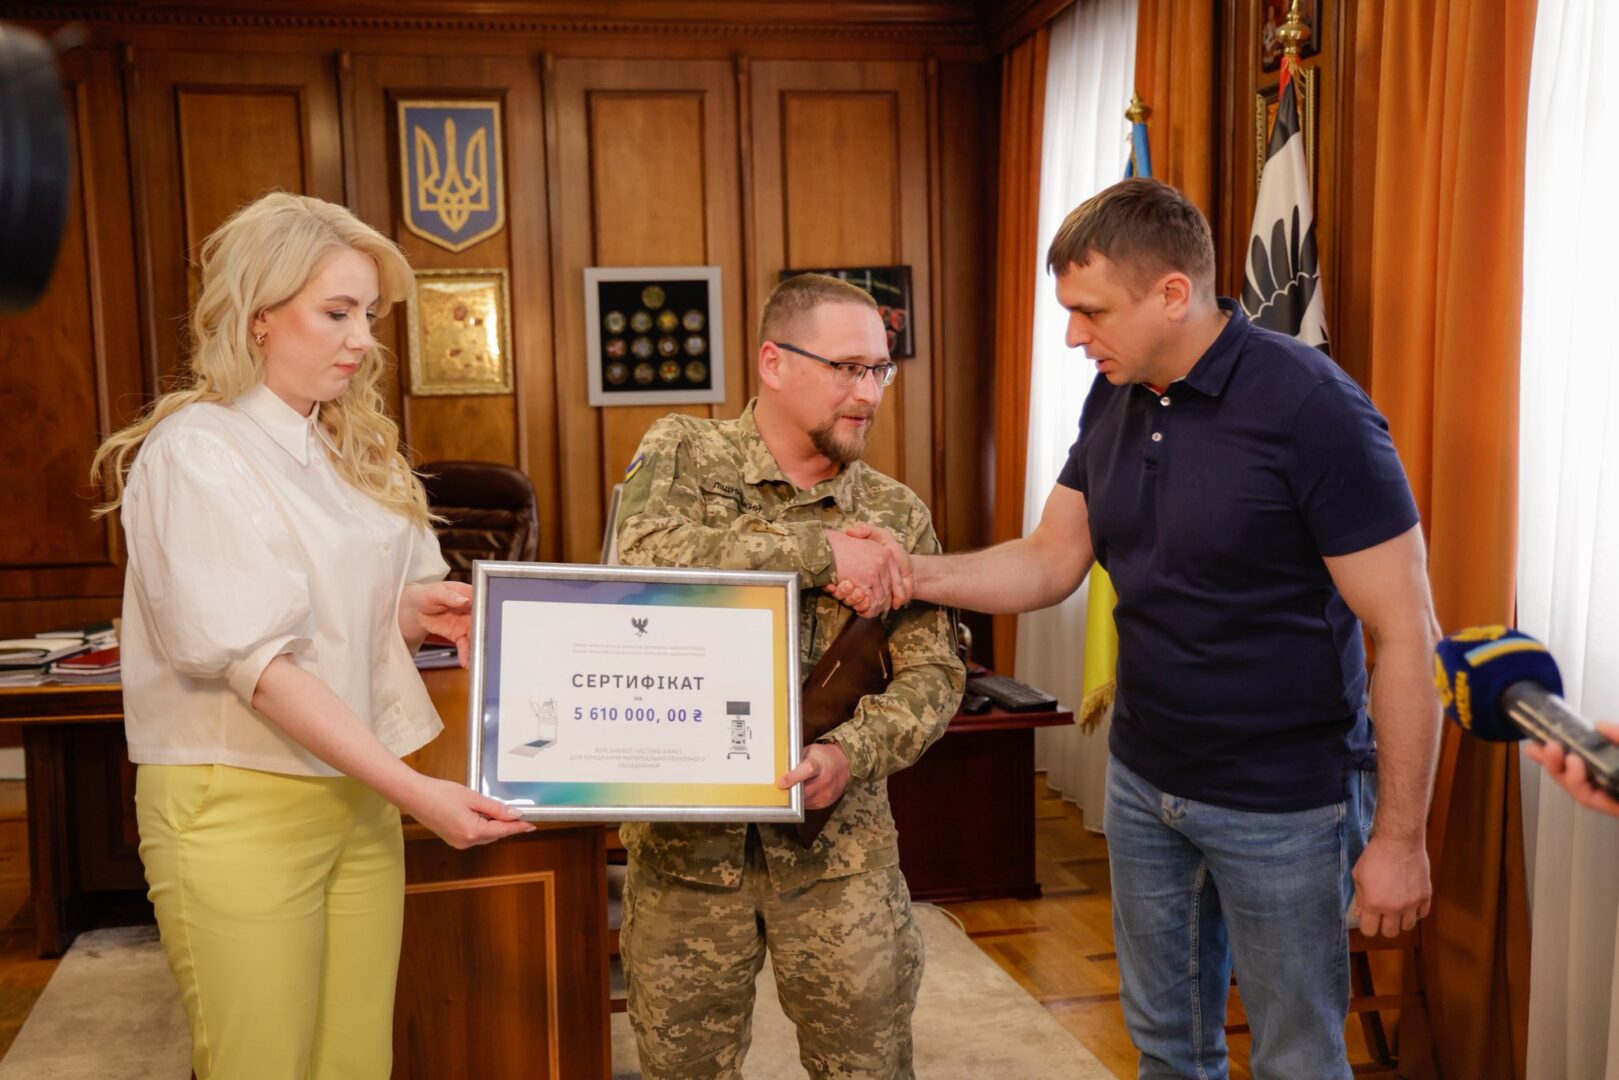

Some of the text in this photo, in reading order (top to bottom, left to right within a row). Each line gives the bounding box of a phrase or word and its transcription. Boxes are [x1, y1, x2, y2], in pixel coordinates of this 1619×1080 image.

[572, 673, 705, 690] СЕРТИФІКАТ
[574, 707, 583, 720] 5
[590, 707, 618, 721] 610
[625, 708, 660, 724] 000,
[667, 709, 687, 722] 00
